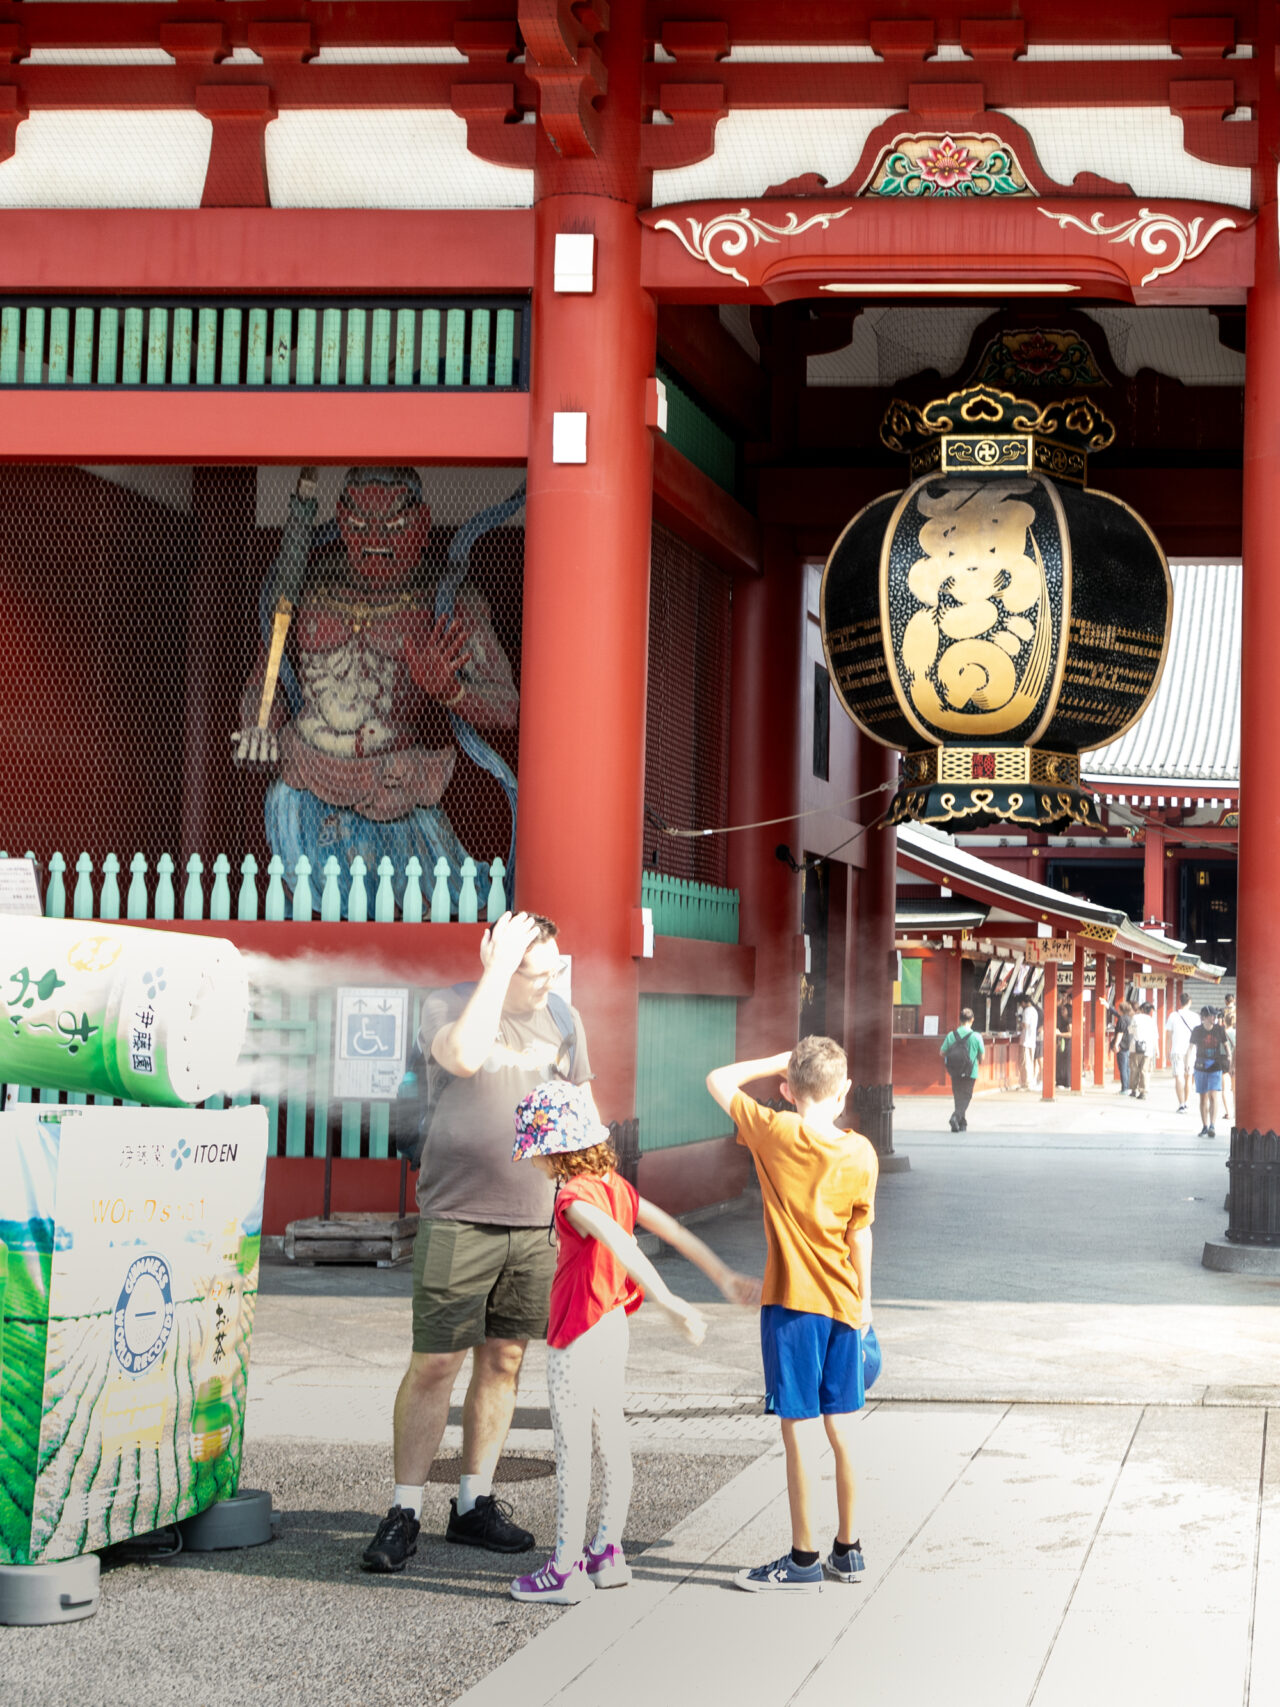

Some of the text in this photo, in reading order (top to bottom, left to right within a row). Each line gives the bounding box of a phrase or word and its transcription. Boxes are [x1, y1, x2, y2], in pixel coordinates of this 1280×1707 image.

[132, 1004, 156, 1074] 伊藤園
[124, 1257, 169, 1294] GUINNESS
[115, 1308, 133, 1369] WORLD
